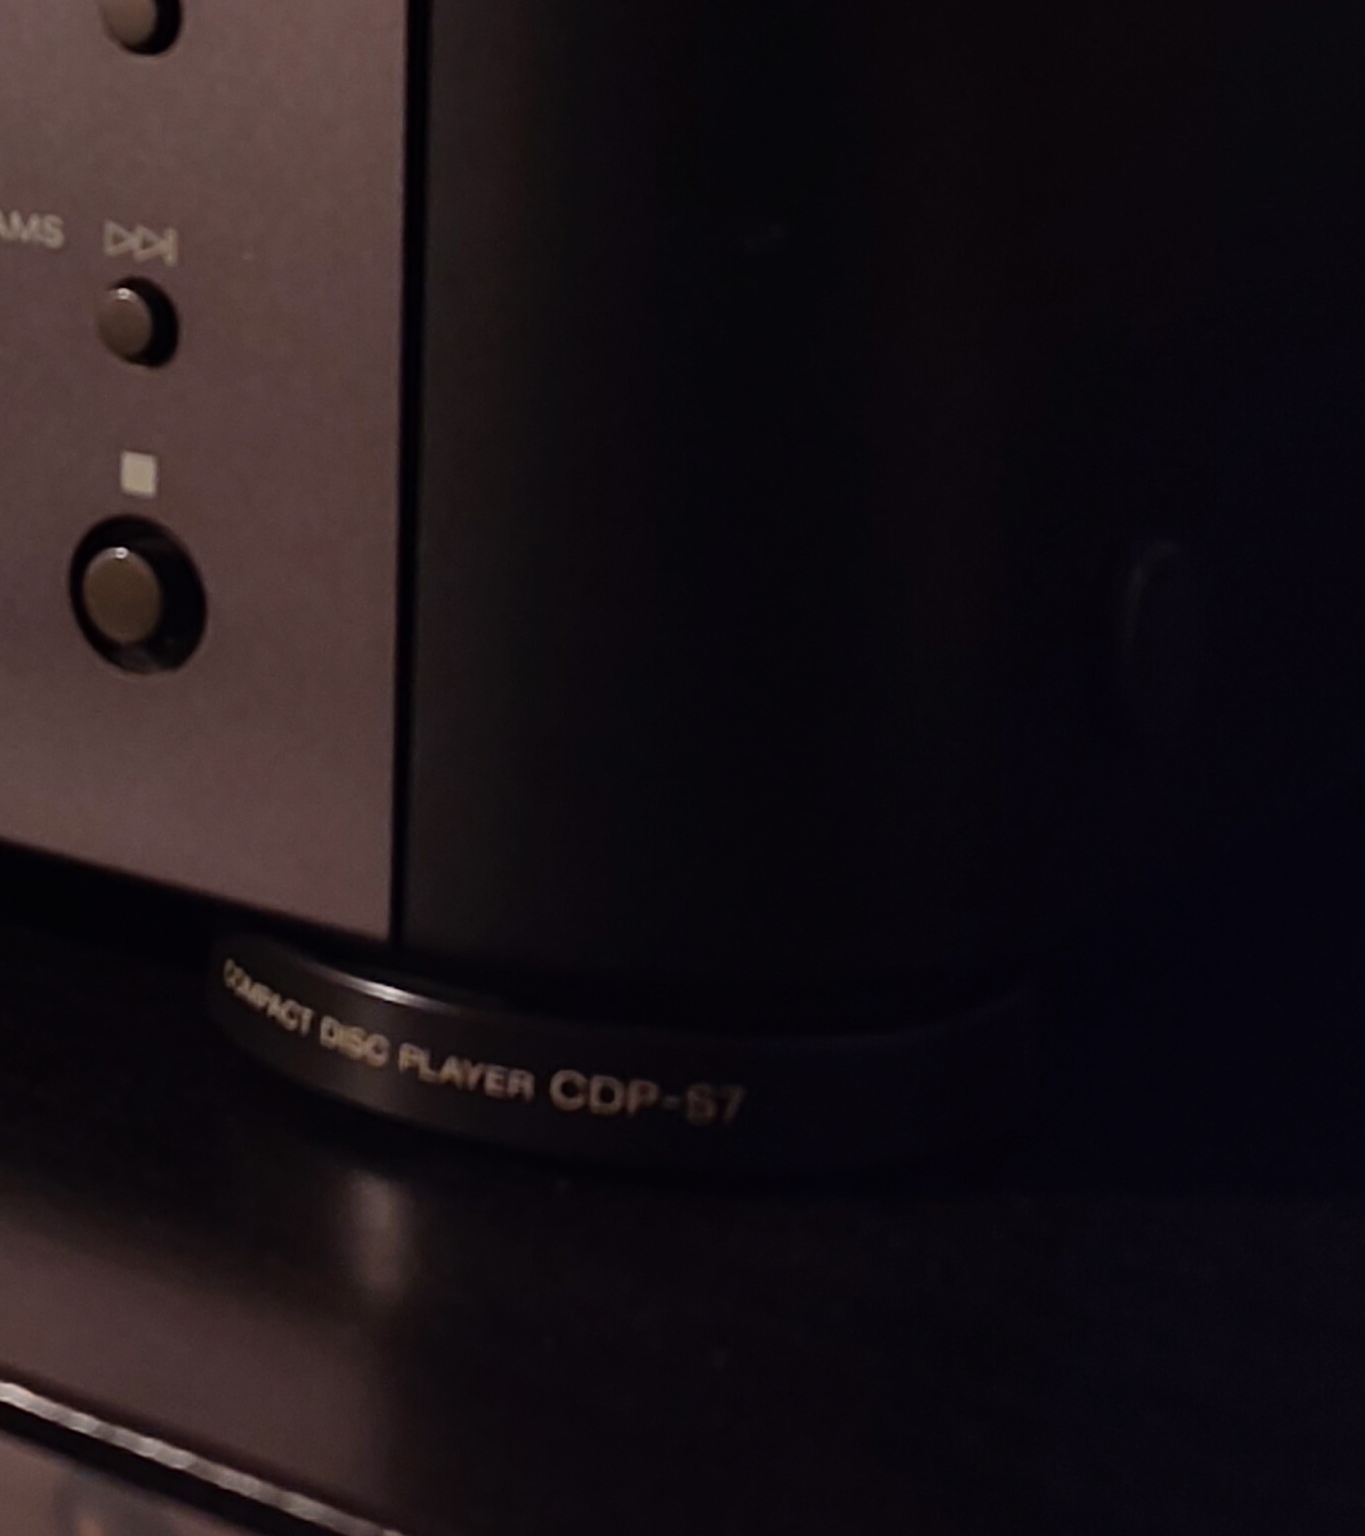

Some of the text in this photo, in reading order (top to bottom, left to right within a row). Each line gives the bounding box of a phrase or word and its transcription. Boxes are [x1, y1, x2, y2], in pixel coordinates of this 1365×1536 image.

[223, 959, 314, 1035] COMPACT
[320, 1015, 390, 1067] DISC
[398, 1042, 535, 1101] PLAYER
